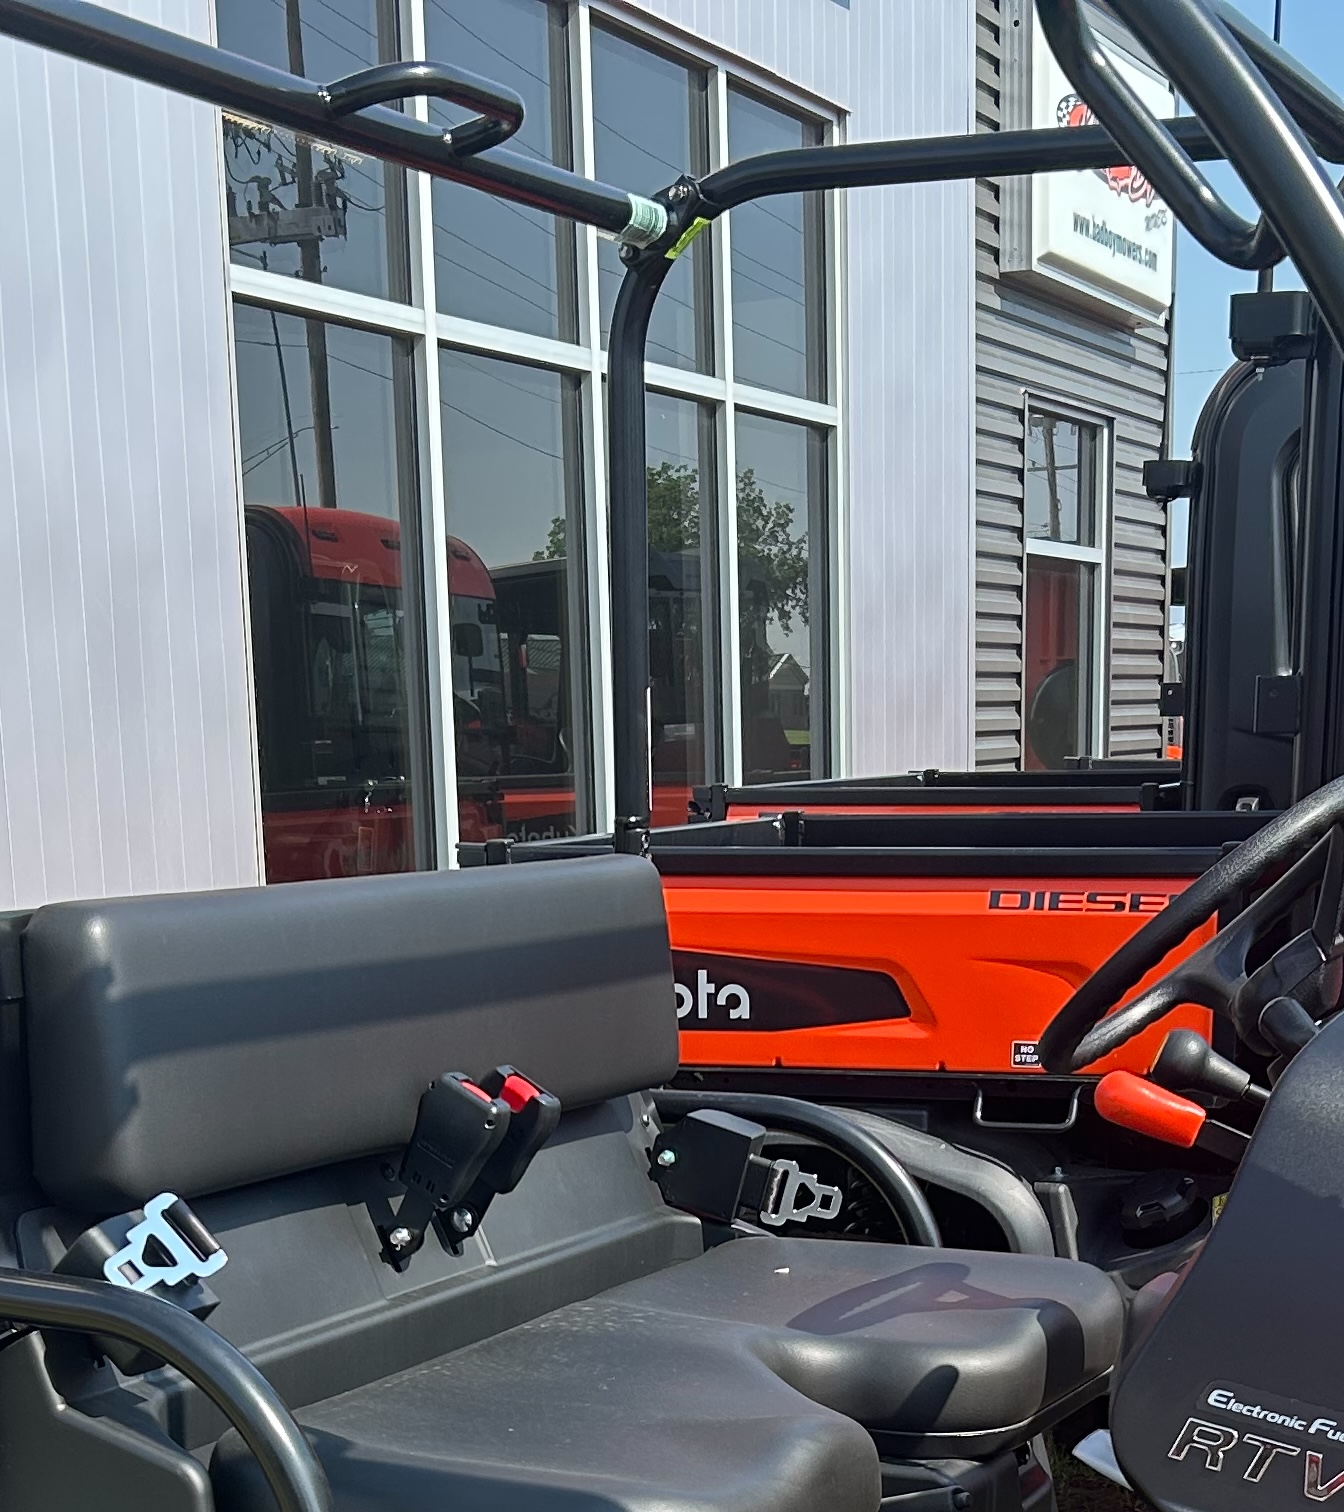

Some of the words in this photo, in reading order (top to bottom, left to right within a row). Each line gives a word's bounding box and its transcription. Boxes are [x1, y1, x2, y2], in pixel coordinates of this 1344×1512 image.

[1073, 211, 1158, 272] www.badboymowers.com
[988, 890, 1180, 913] DIESE
[674, 969, 751, 1020] ota
[1014, 1054, 1039, 1063] STEP
[1020, 1045, 1035, 1054] NO
[1207, 1388, 1307, 1431] Electronic
